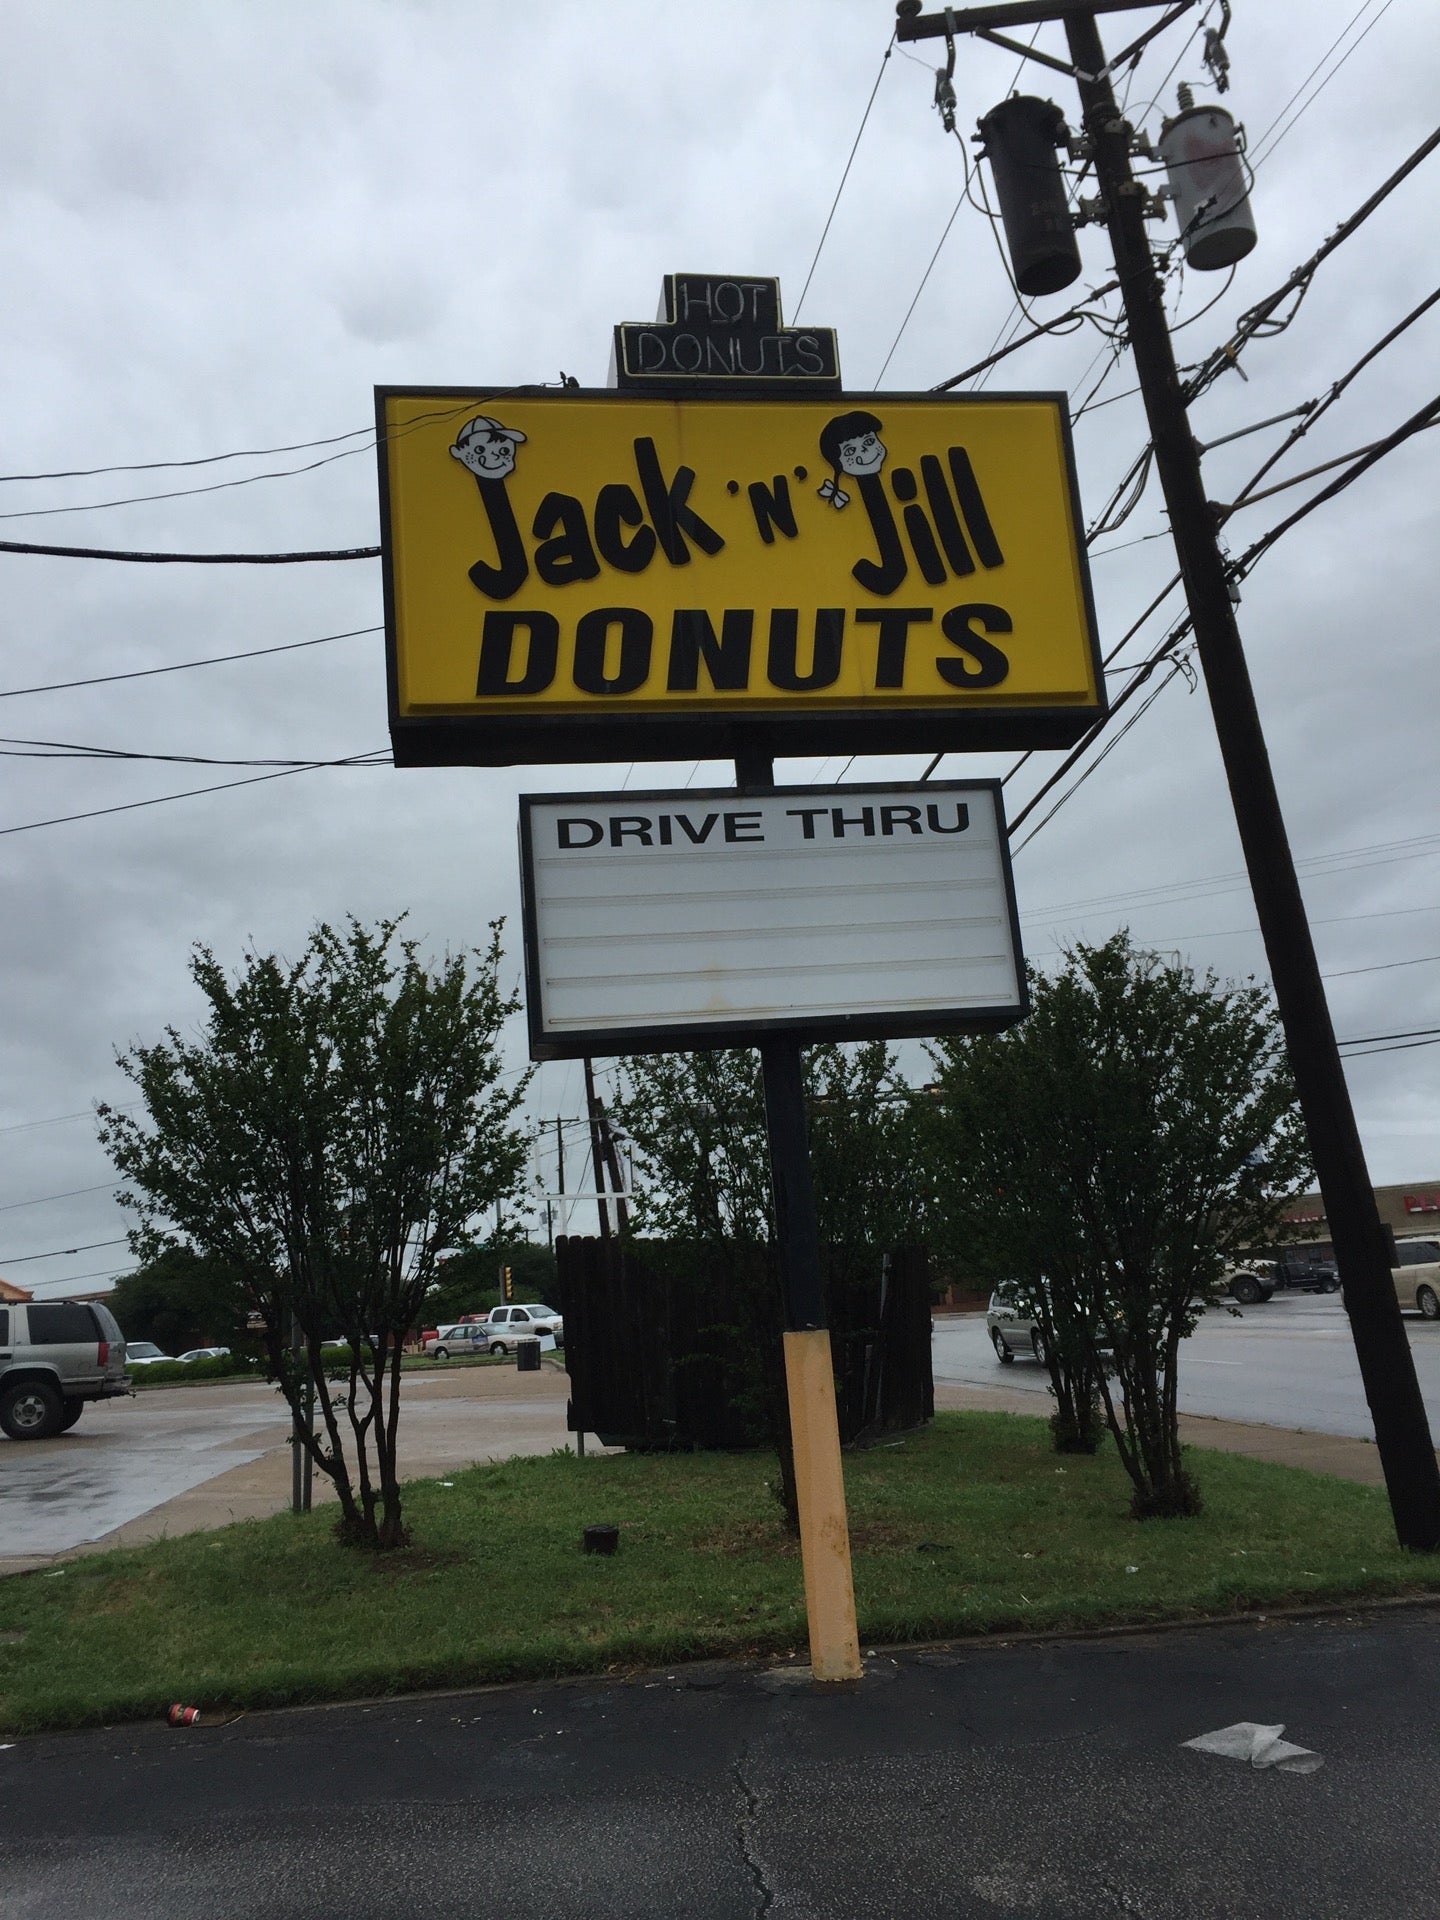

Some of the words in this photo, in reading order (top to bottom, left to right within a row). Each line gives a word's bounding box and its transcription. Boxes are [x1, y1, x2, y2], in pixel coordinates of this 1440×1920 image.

[679, 282, 768, 323] HOT
[637, 333, 824, 375] DONUTS
[468, 437, 725, 600] Jack
[851, 446, 1005, 597] Jill
[475, 604, 1014, 697] DONUTS
[557, 811, 765, 849] DRIVE
[786, 803, 970, 839] THRU
